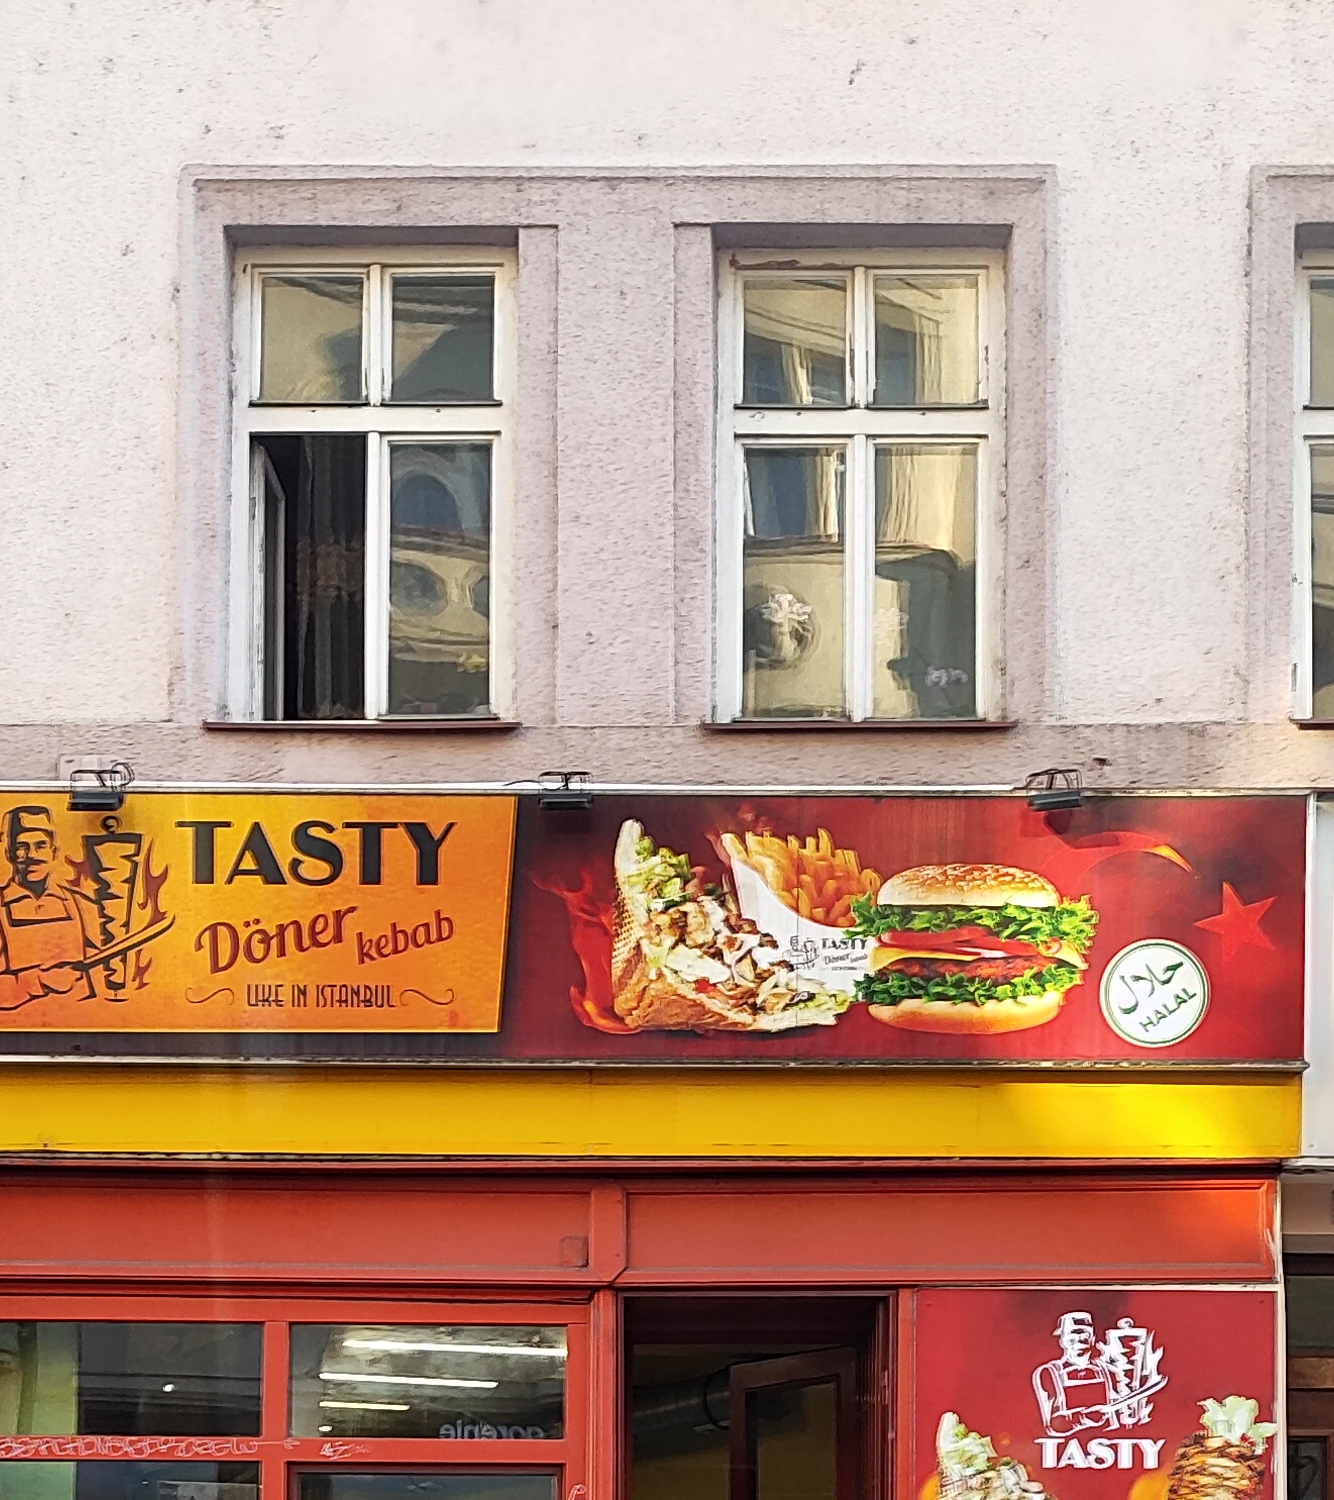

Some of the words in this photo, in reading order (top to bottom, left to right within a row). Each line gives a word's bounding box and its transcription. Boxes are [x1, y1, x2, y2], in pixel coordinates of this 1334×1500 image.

[174, 820, 457, 886] TASTY
[195, 905, 356, 974] Döner
[355, 908, 455, 966] kebab
[821, 937, 868, 950] TASTY
[246, 983, 285, 1008] LIKE
[291, 983, 308, 1008] IN
[315, 983, 395, 1008] ISTANBUL
[1118, 961, 1184, 1015] حلال
[1139, 987, 1198, 1033] HALAL
[1033, 1437, 1167, 1470] TASTY
